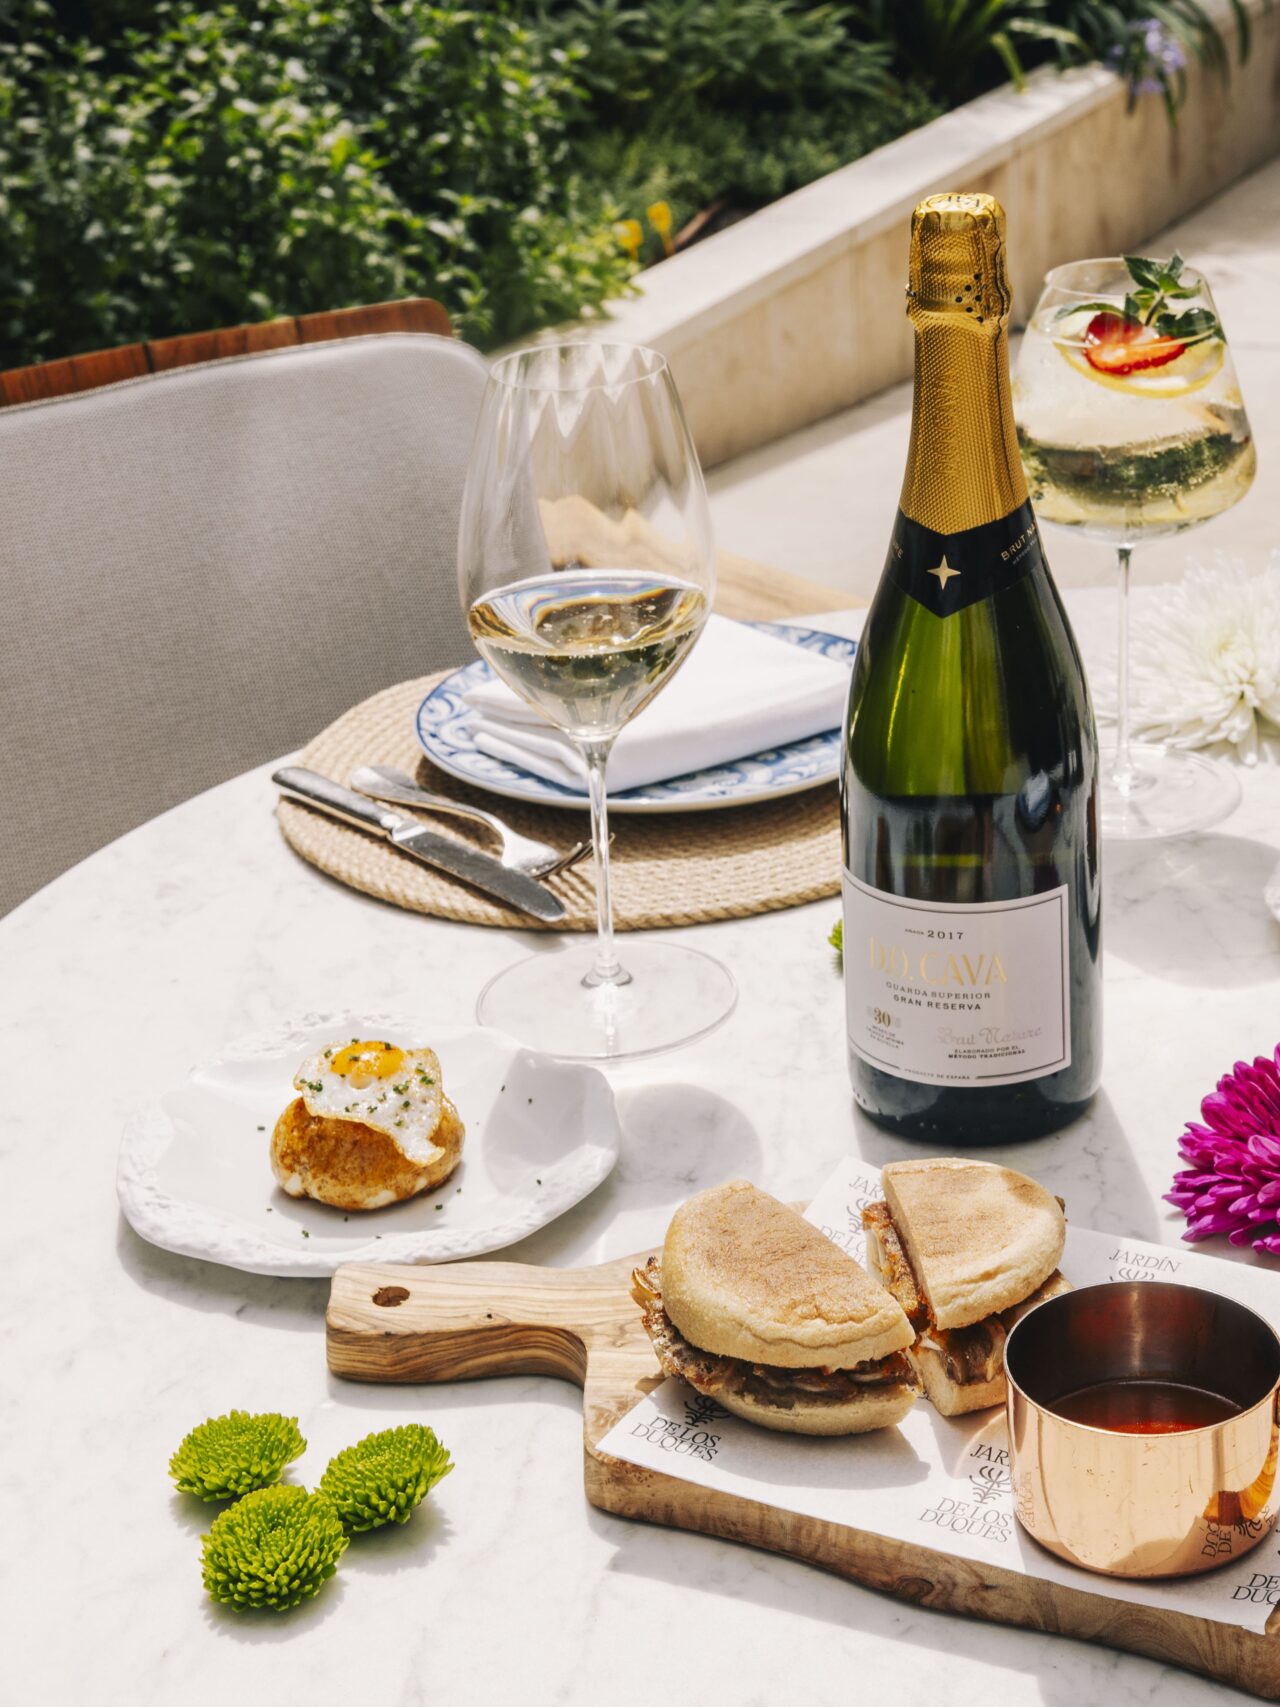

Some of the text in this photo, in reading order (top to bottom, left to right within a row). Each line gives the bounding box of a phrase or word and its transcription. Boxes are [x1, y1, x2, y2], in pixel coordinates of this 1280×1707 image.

[1001, 534, 1026, 561] BRUT
[927, 930, 964, 940] 2017
[919, 952, 1009, 986] CAVA
[885, 981, 991, 1000] GUARDA SUPERIOR
[894, 994, 982, 1011] GRAN RESERVA
[873, 1008, 891, 1028] 30
[849, 1175, 884, 1200] JAR
[1109, 1248, 1182, 1273] JARDÍN
[630, 1423, 718, 1462] DUQUES
[649, 1416, 722, 1448] DE LOS
[969, 1443, 1010, 1468] JAR
[936, 1496, 1013, 1528] DE LOS
[919, 1508, 1012, 1543] DUQUES
